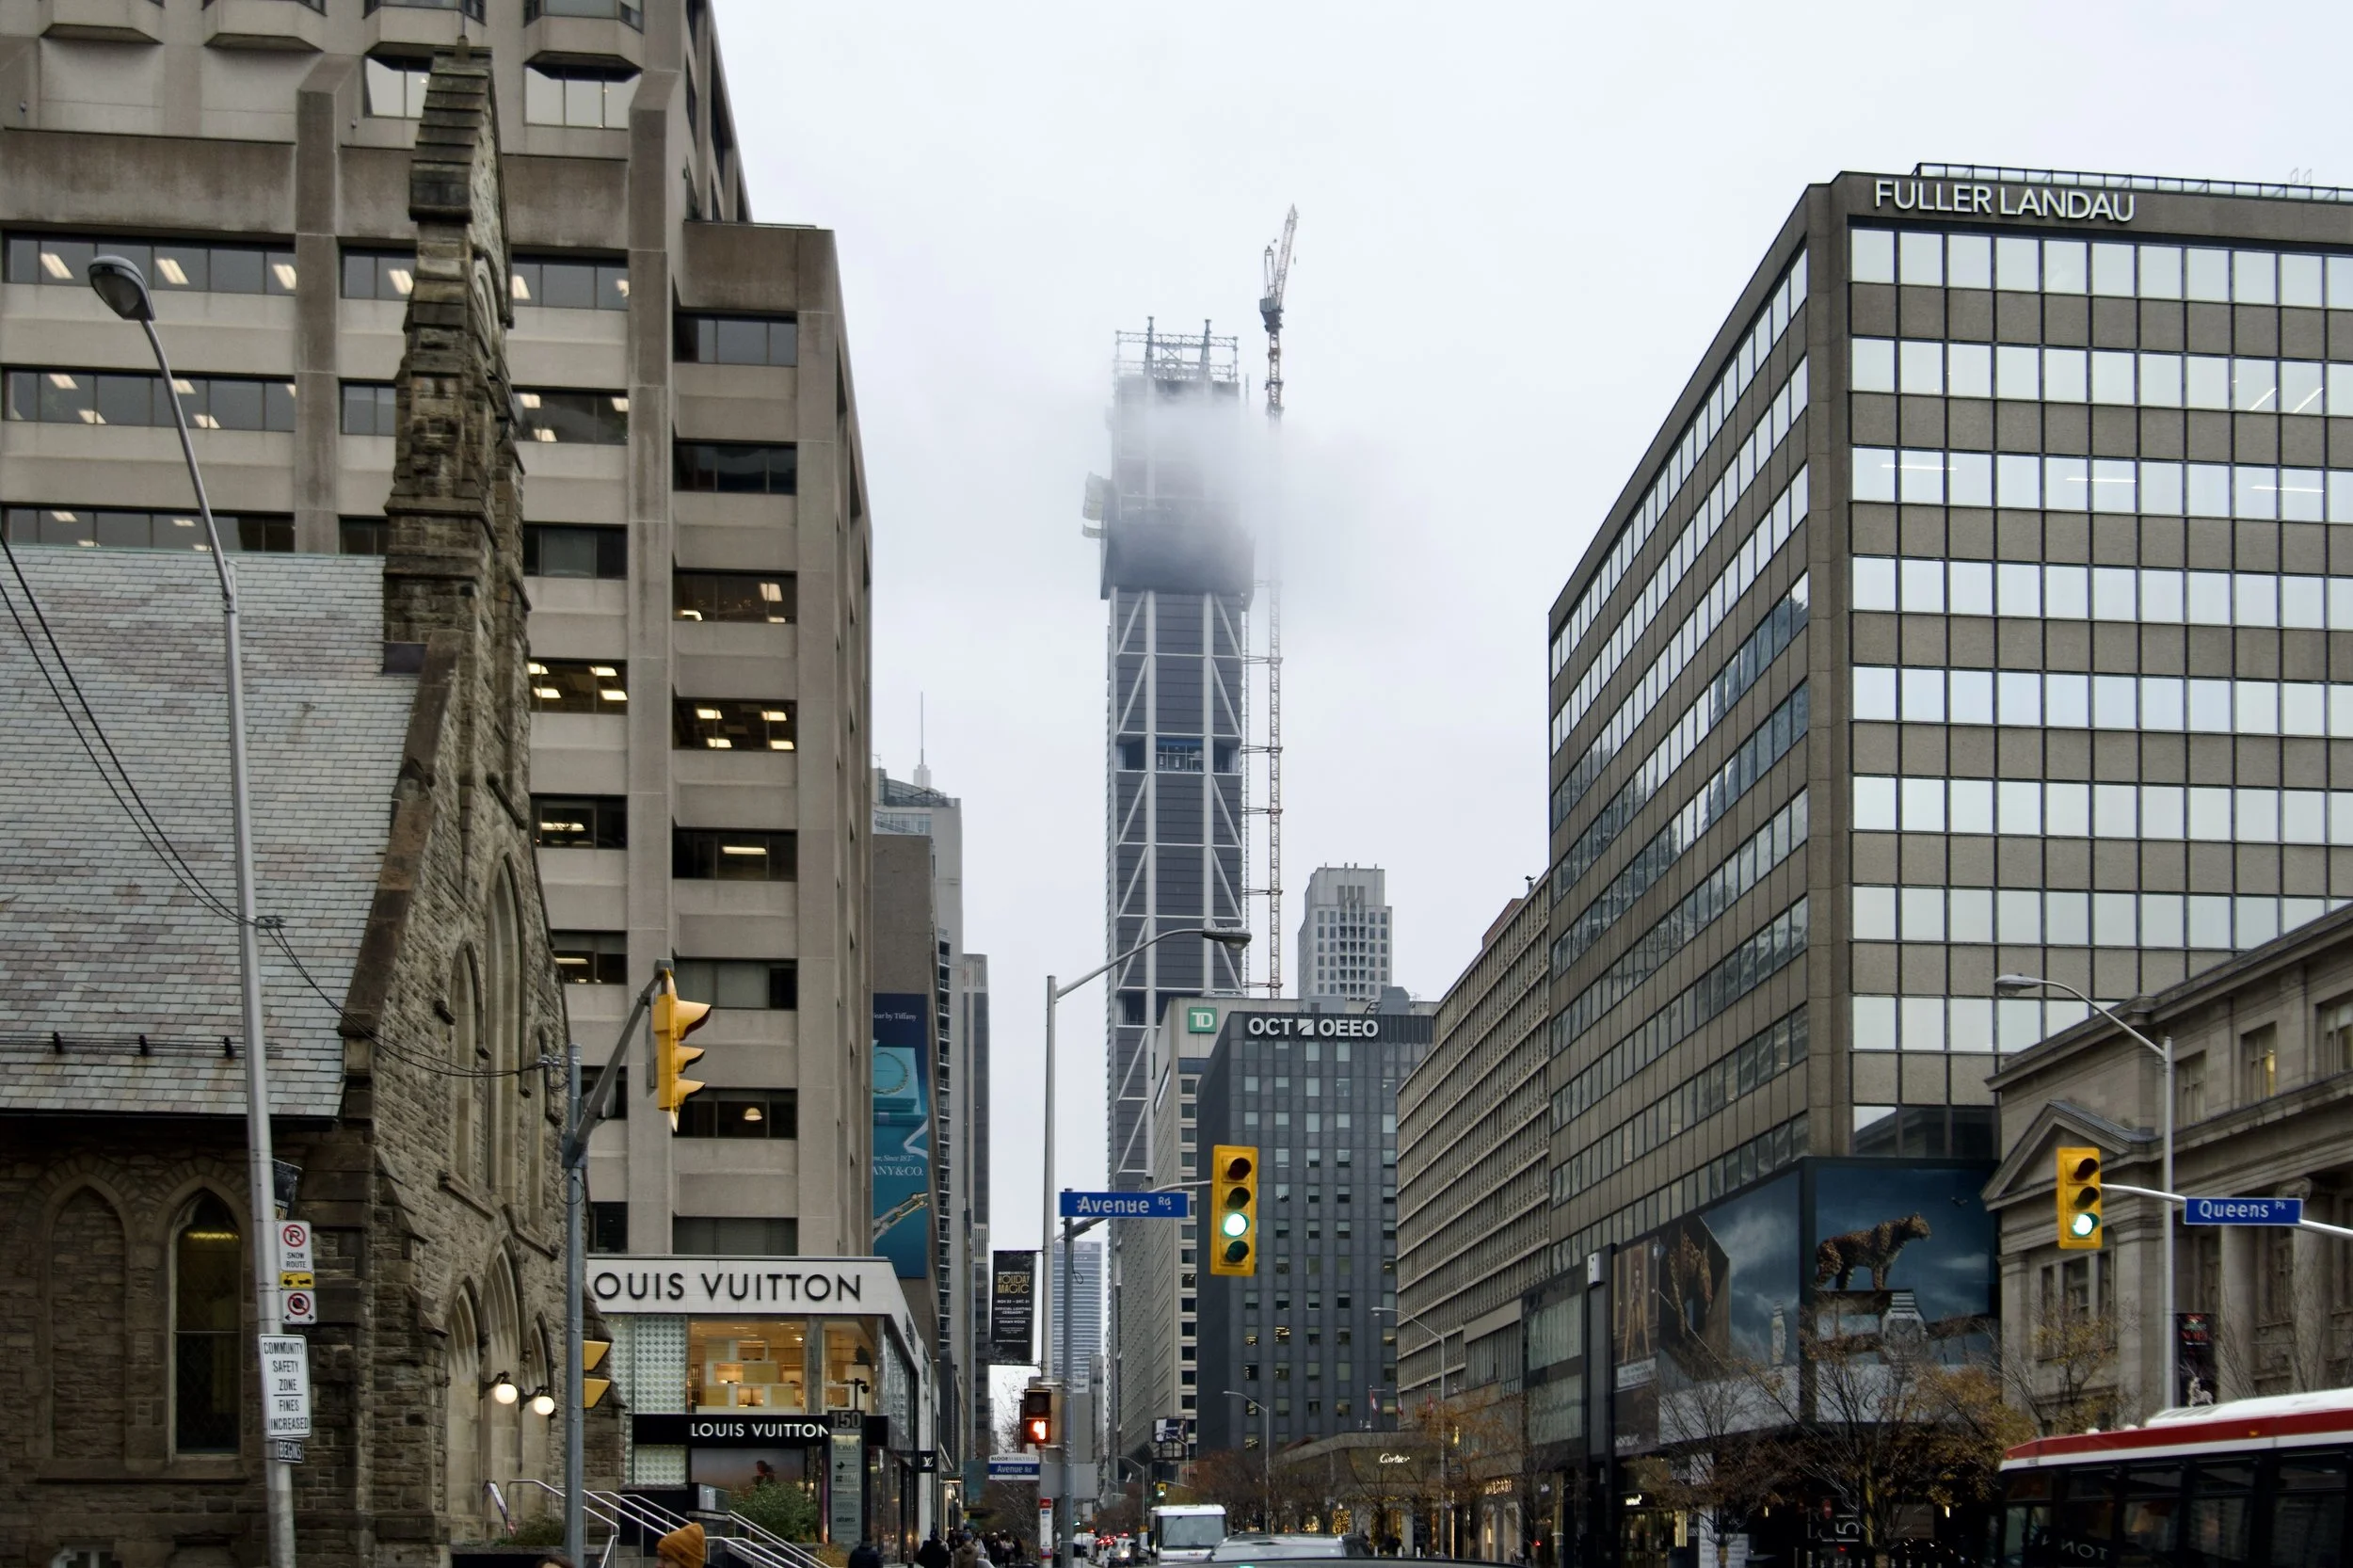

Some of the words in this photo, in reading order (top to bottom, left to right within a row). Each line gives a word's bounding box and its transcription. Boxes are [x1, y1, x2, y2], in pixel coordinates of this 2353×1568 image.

[1875, 180, 1993, 215] FULLER
[1999, 188, 2135, 222] LANDAU
[894, 1012, 918, 1022] Tiffany
[1192, 1012, 1214, 1028] TD
[1248, 1017, 1294, 1036] OCT
[1319, 1018, 1379, 1037] OEEO
[1079, 1196, 1150, 1214] Avenue
[1159, 1196, 1171, 1206] Rd
[2199, 1200, 2269, 1219] Queens
[2274, 1201, 2286, 1210] Pk
[998, 1274, 1030, 1284] HOLIDAY
[594, 1272, 685, 1302] OUIS
[701, 1273, 861, 1302] VUITTON
[998, 1284, 1030, 1293] MAGIC
[264, 1342, 304, 1354] COMMUNITY
[273, 1360, 299, 1372] SAFETY
[279, 1379, 297, 1391] ZONE
[279, 1400, 300, 1412] FINES
[270, 1417, 309, 1431] INCREASED
[832, 1412, 861, 1428] 150
[690, 1423, 744, 1436] LOUIS
[751, 1423, 828, 1437] VUITTON
[280, 1441, 302, 1460] BEGINS
[1380, 1452, 1411, 1464] Cartier
[997, 1464, 1023, 1474] Avenue
